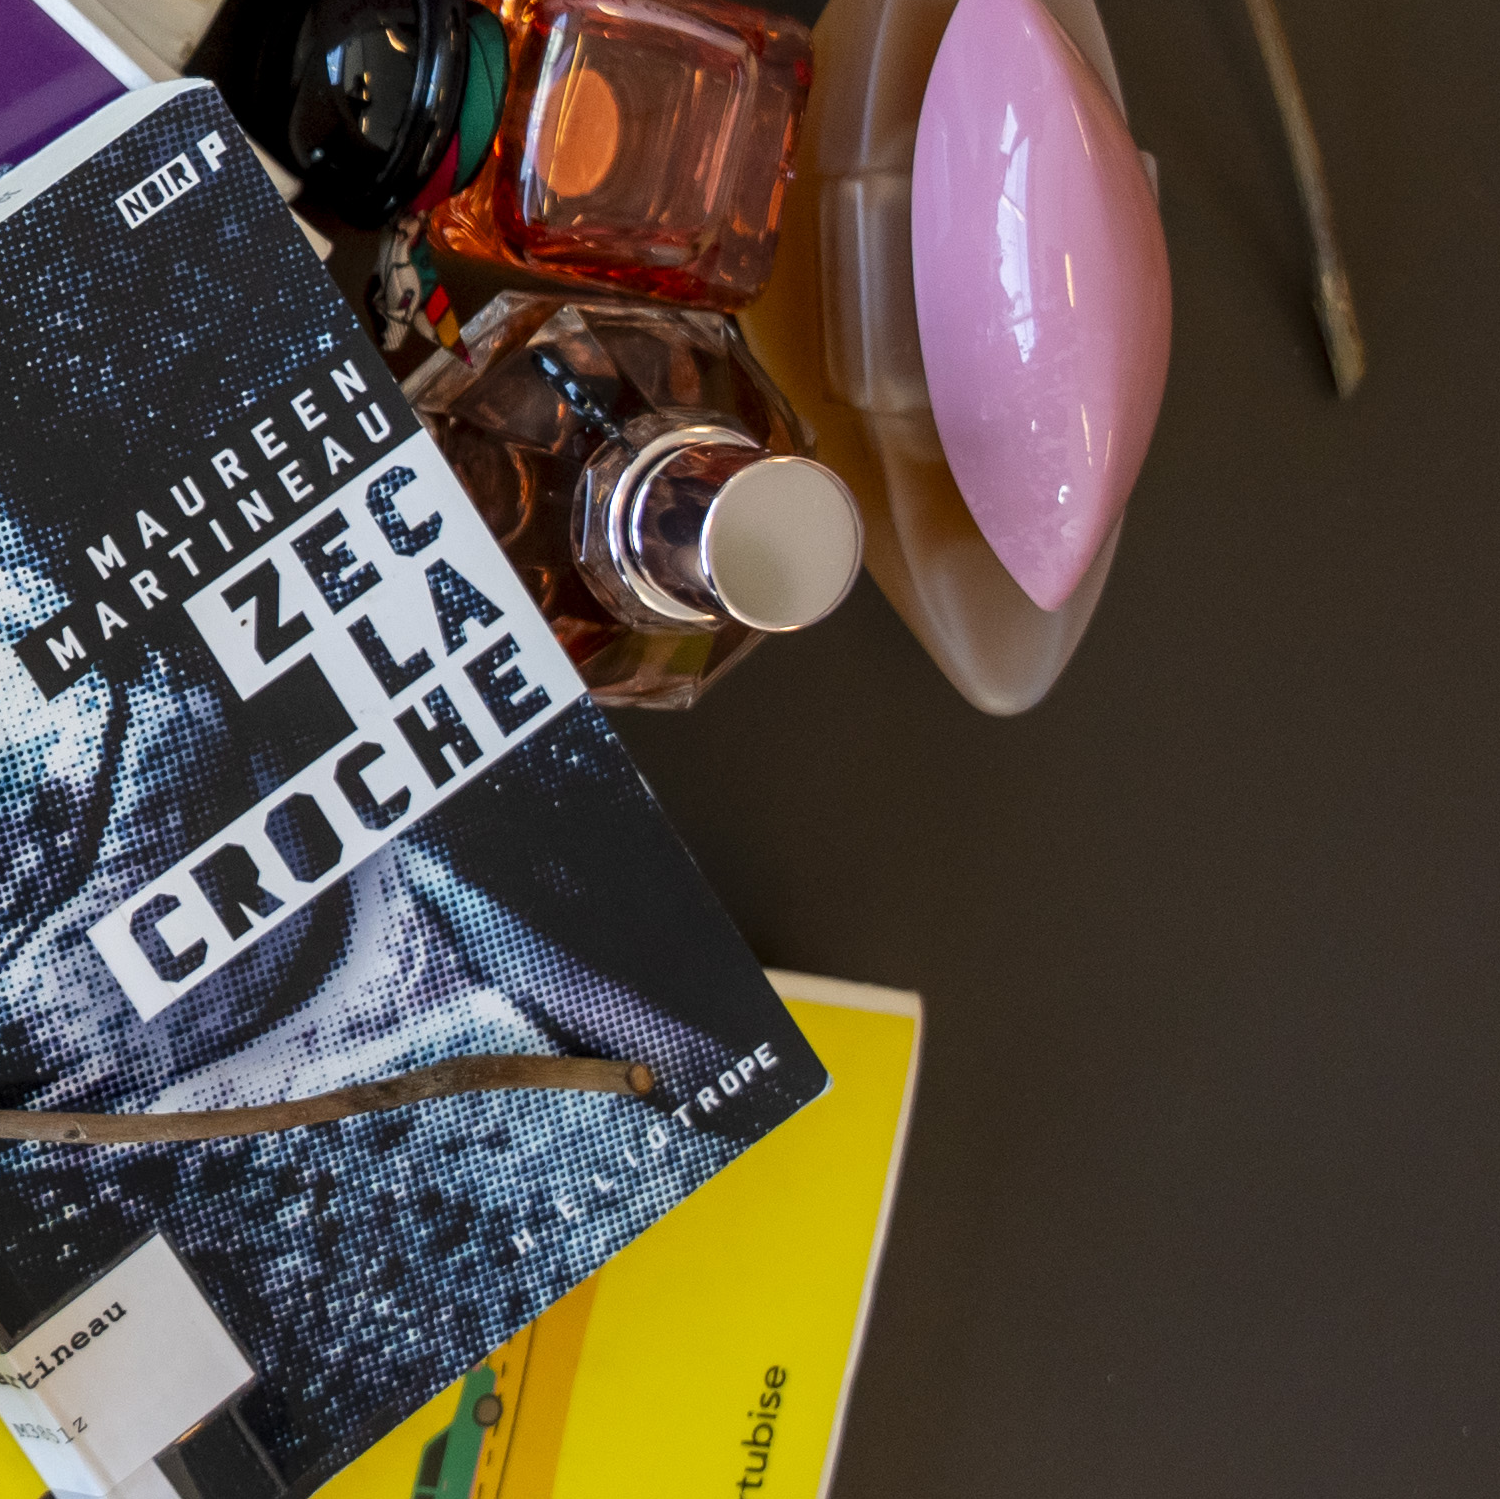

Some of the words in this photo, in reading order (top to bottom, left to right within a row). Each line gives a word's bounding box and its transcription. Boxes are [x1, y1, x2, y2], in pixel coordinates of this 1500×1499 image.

[46, 400, 395, 673] MARTINEAU
[86, 358, 370, 581] MAUREEN
[221, 464, 443, 665] ZEC
[347, 557, 505, 700] LA
[128, 631, 553, 983] CROCHE
